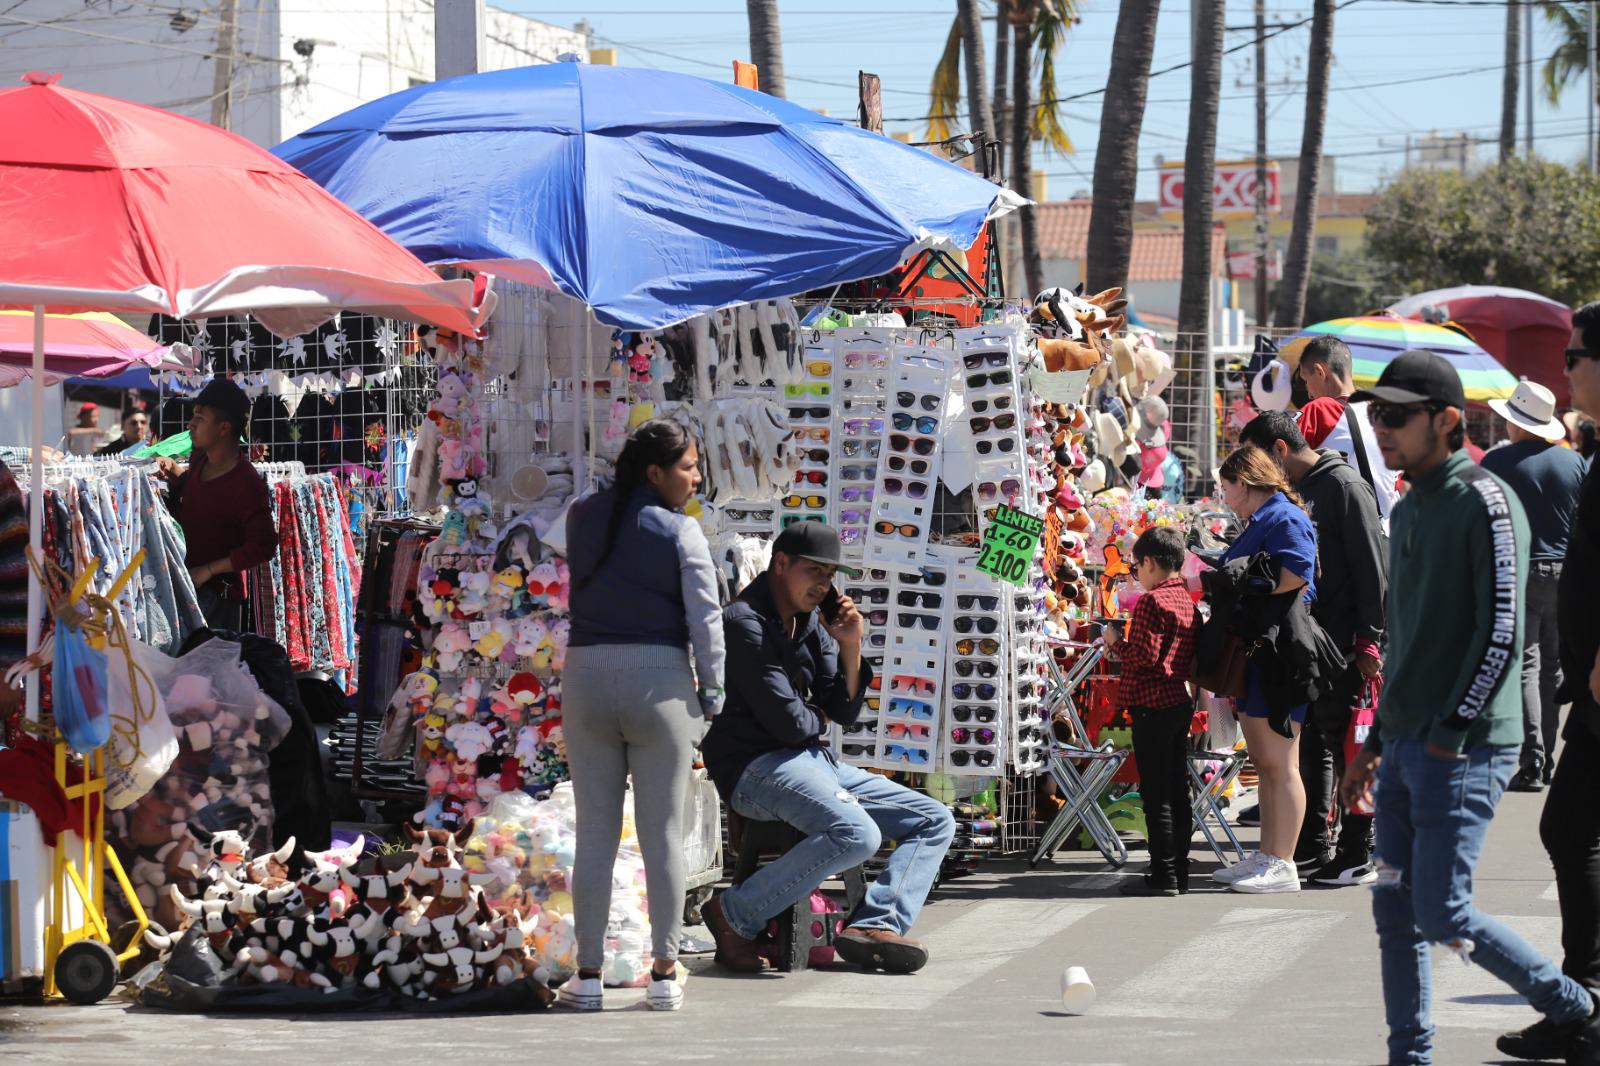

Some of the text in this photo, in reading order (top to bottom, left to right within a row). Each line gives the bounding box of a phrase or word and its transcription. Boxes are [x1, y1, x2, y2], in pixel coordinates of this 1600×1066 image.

[1162, 171, 1275, 207] OXO
[995, 505, 1041, 532] LENTES
[976, 543, 1026, 581] 2-100
[1491, 518, 1516, 645] UNREMITTING
[1457, 646, 1509, 719] EFFORTS
